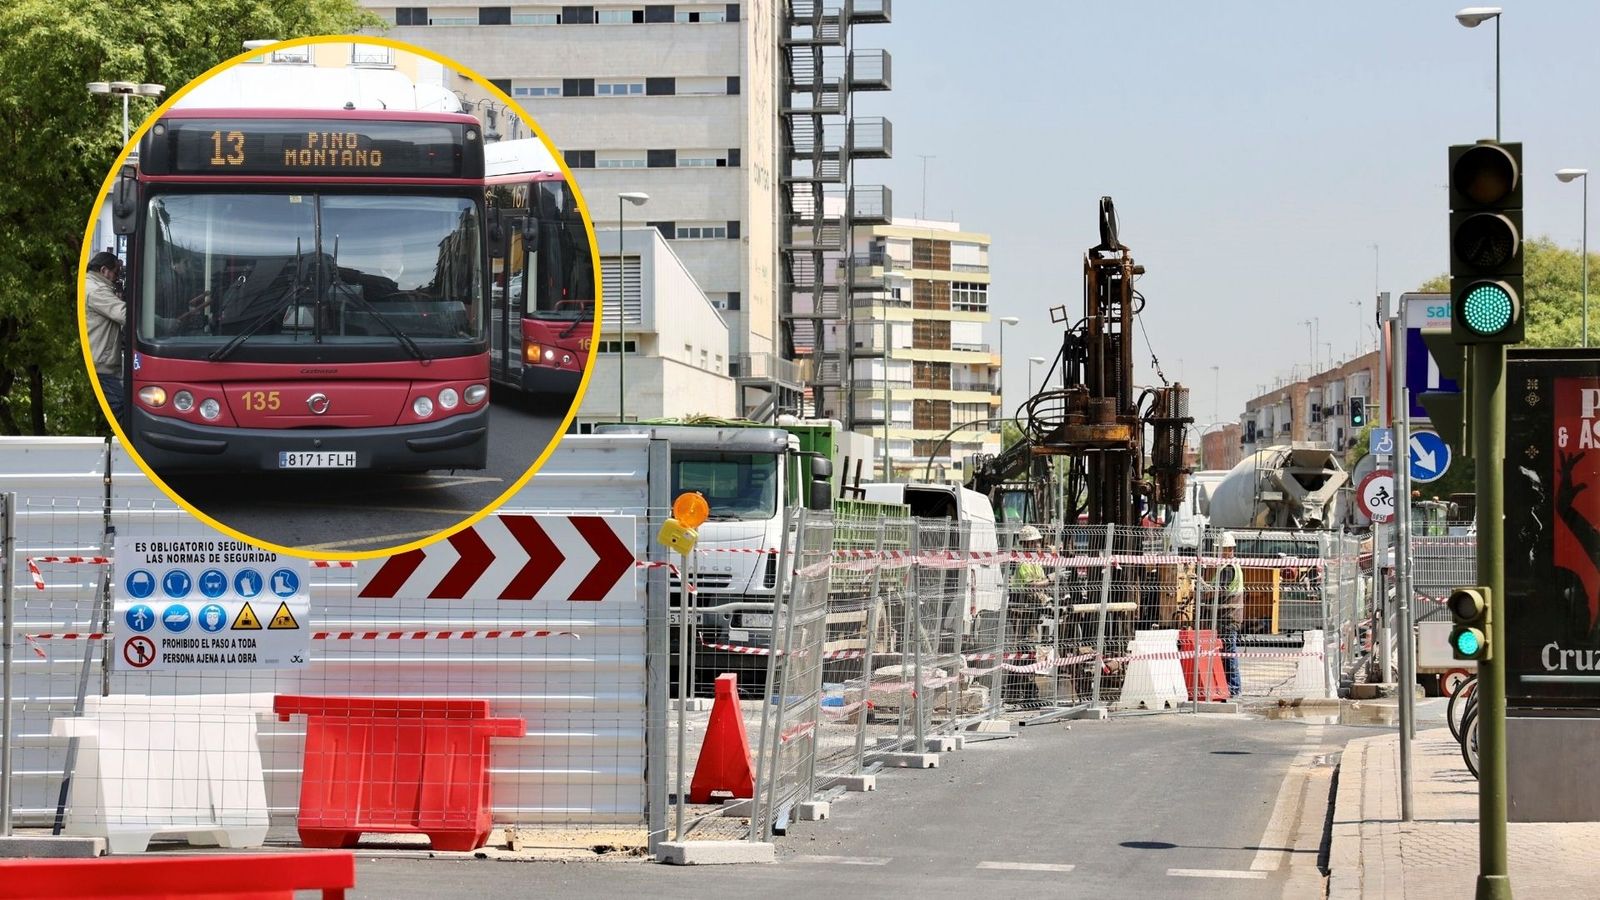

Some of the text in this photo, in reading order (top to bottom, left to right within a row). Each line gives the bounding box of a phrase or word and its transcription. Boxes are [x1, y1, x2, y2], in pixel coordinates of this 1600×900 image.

[308, 132, 358, 149] PINO
[210, 130, 245, 165] 13
[285, 149, 382, 167] MONTANO
[241, 391, 281, 411] 135
[288, 453, 354, 466] 8171 FLH
[135, 542, 147, 552] ES
[150, 541, 214, 552] OBLIGATORIO
[146, 552, 277, 563] LAS NORMAS DE SEGURIDAD
[162, 638, 257, 648] PROHIBIDO EL PASO A TODA
[162, 653, 257, 663] PERSONA AJENA A LA OBRA
